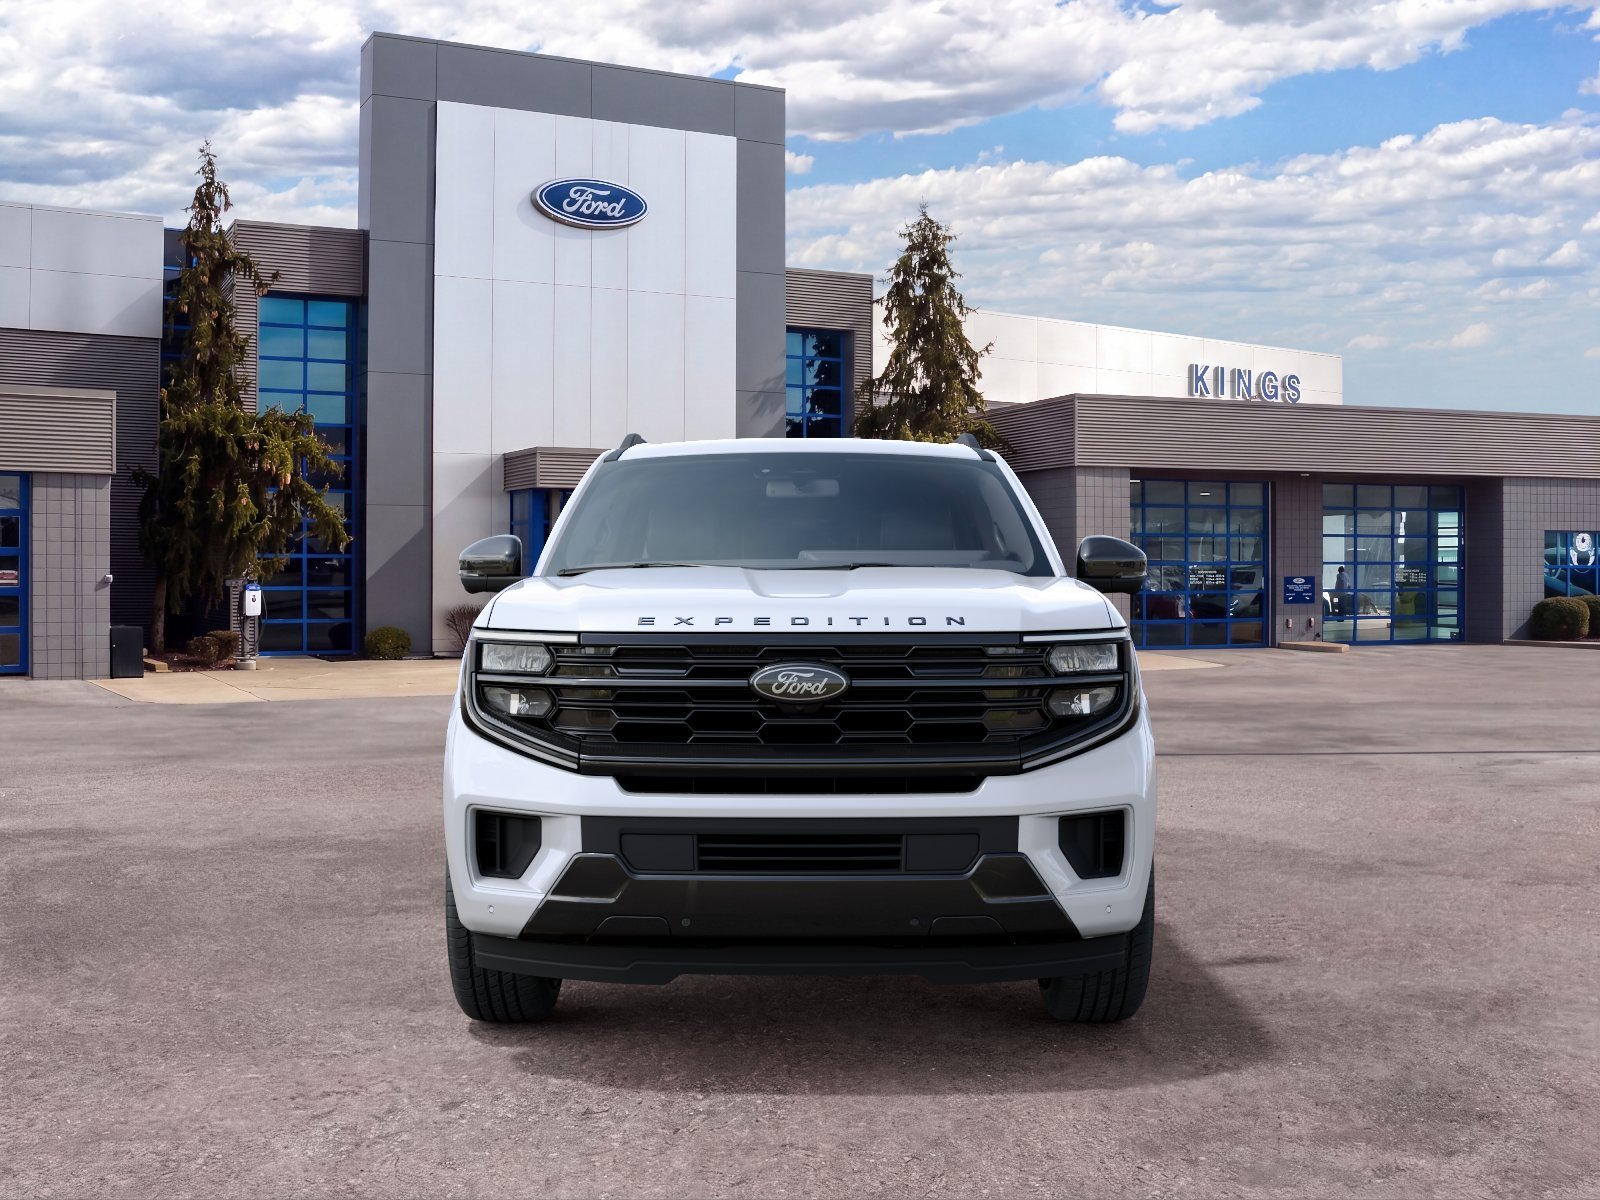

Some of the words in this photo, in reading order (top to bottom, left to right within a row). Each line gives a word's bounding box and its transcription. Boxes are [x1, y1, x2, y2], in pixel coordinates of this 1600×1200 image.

[562, 186, 627, 217] Ford
[1189, 363, 1301, 404] KINGS
[637, 616, 966, 626] EXPEDITION
[771, 671, 827, 695] Ford
